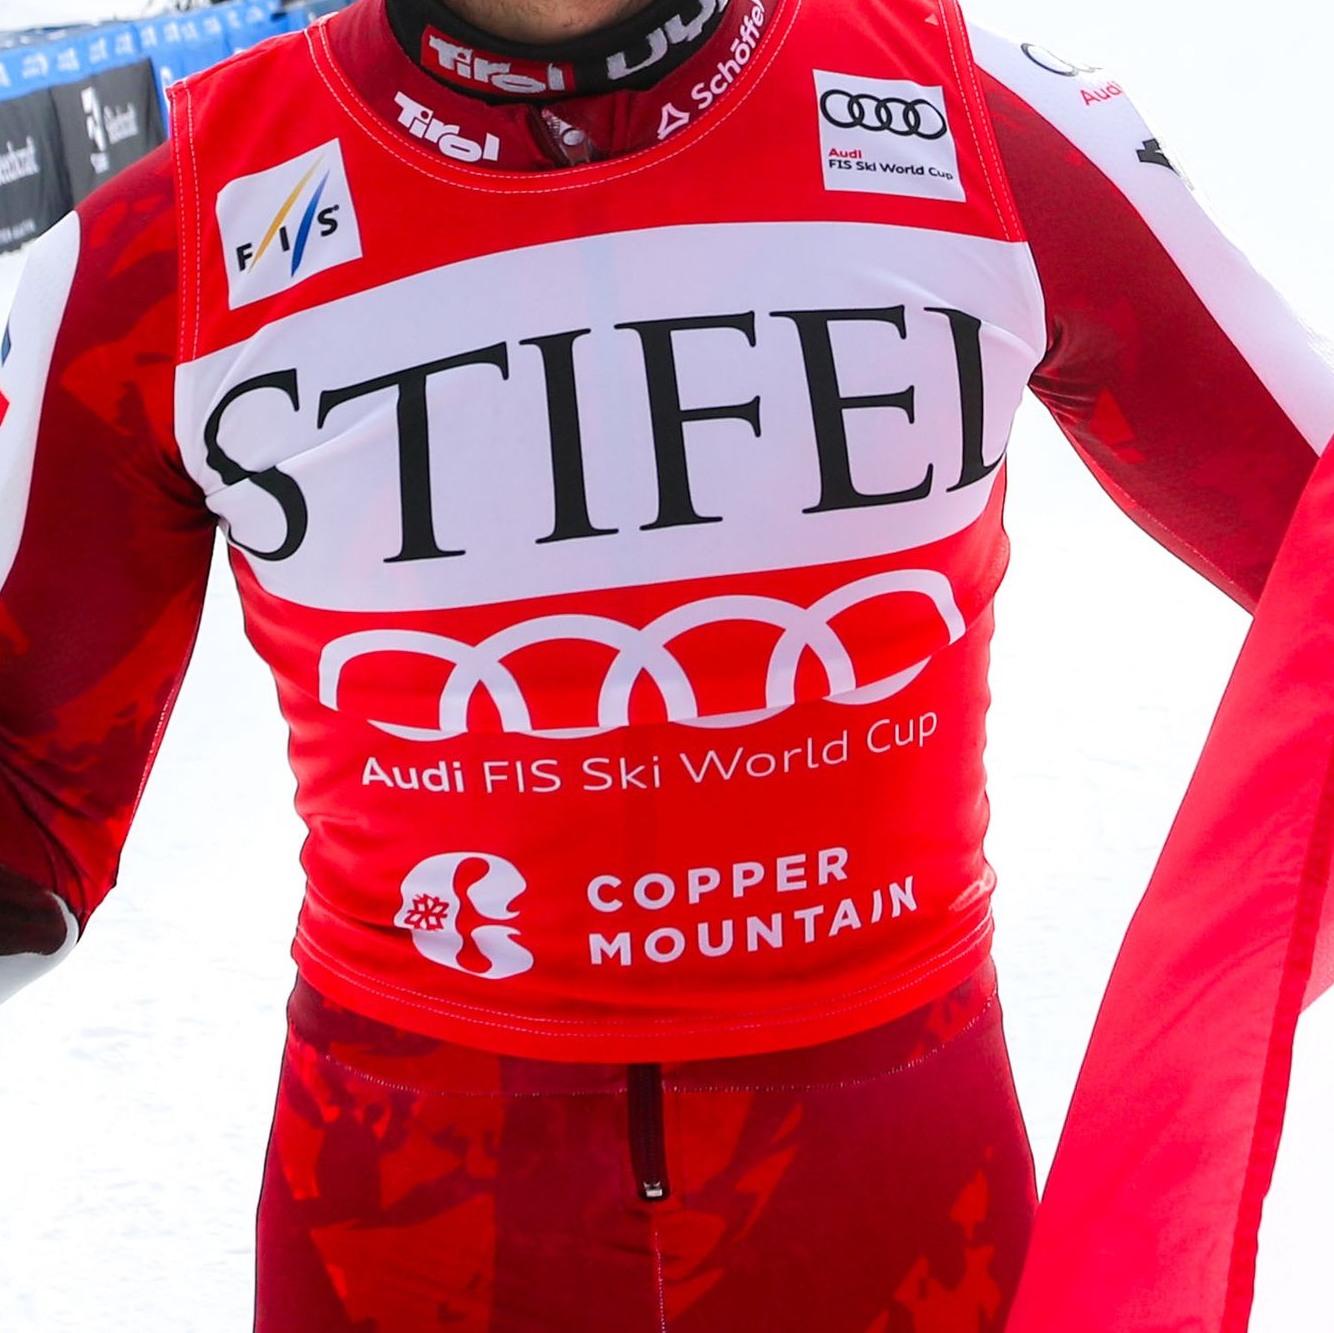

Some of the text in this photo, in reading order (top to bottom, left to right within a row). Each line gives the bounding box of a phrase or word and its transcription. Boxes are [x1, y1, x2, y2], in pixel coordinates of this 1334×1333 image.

[429, 33, 565, 94] Tirol
[394, 91, 500, 164] Tirol
[828, 147, 862, 159] Audi
[828, 159, 954, 180] FIS Ski World Cup
[203, 304, 1008, 565] STIFEL
[362, 709, 939, 794] Audi FIS Ski World Cup
[587, 845, 851, 915] COPPER
[587, 875, 919, 968] MOUNTAIN
